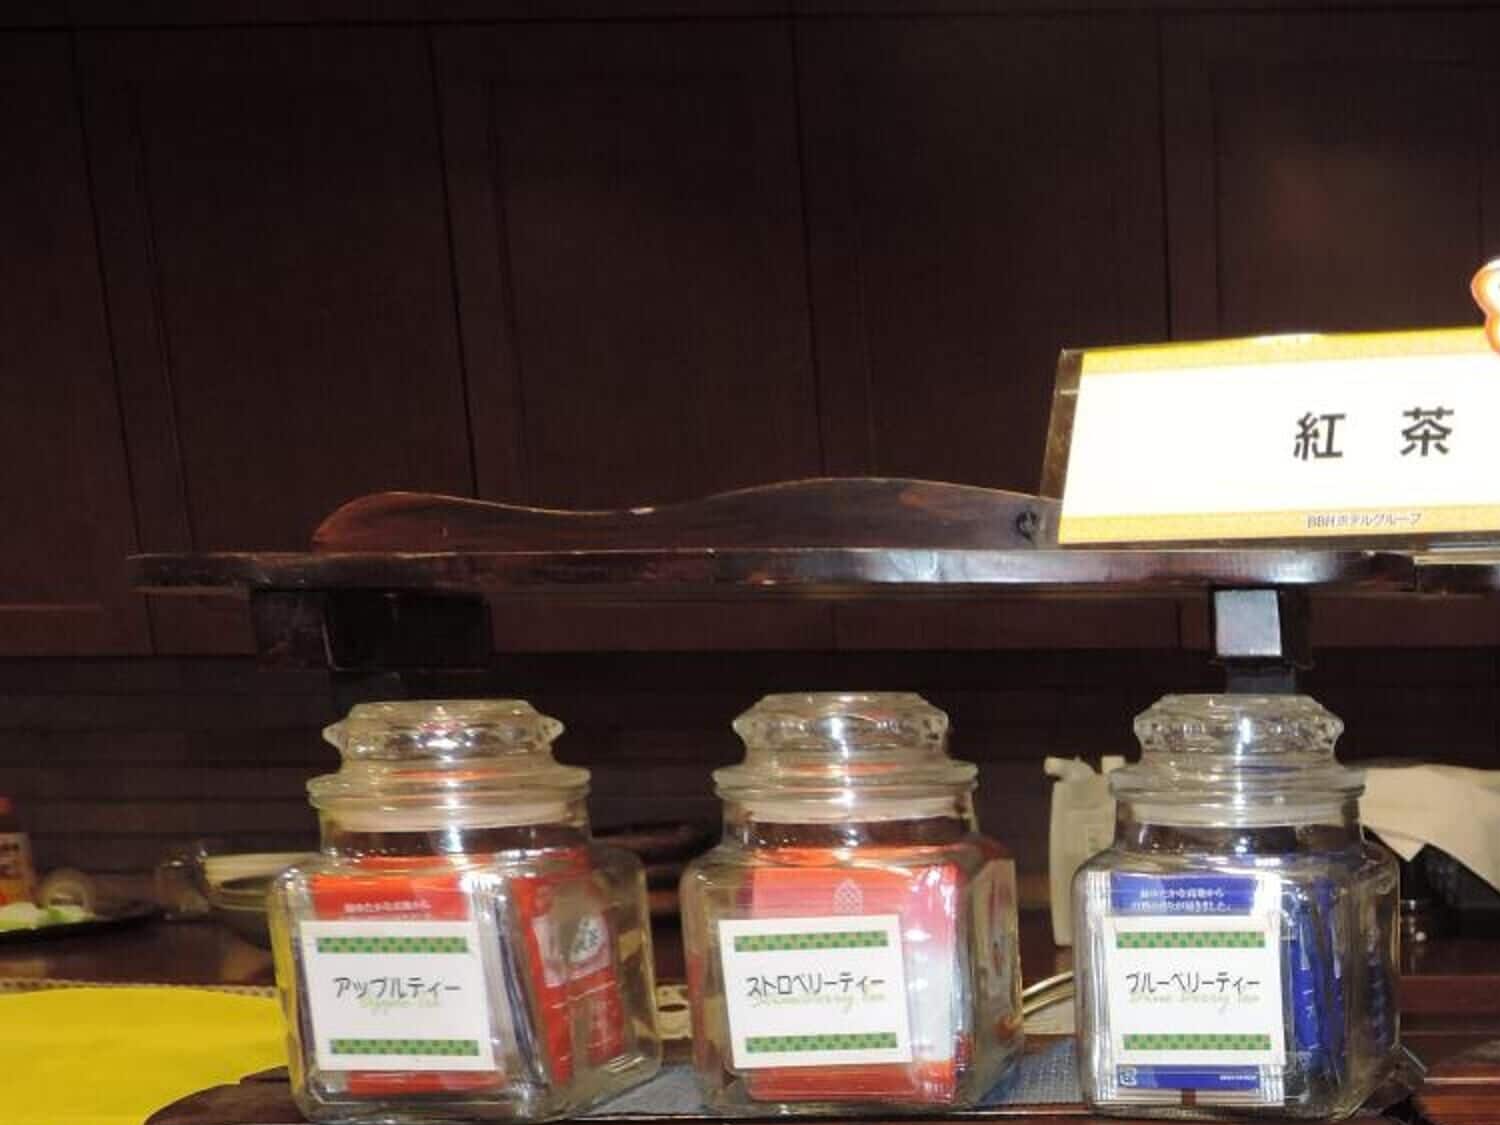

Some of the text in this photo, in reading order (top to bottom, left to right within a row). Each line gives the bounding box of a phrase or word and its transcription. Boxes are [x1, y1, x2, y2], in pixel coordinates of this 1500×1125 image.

[332, 976, 462, 999] アップルティー
[745, 971, 886, 997] ストロベリーティー
[1125, 970, 1261, 994] ブルーベリーティー
